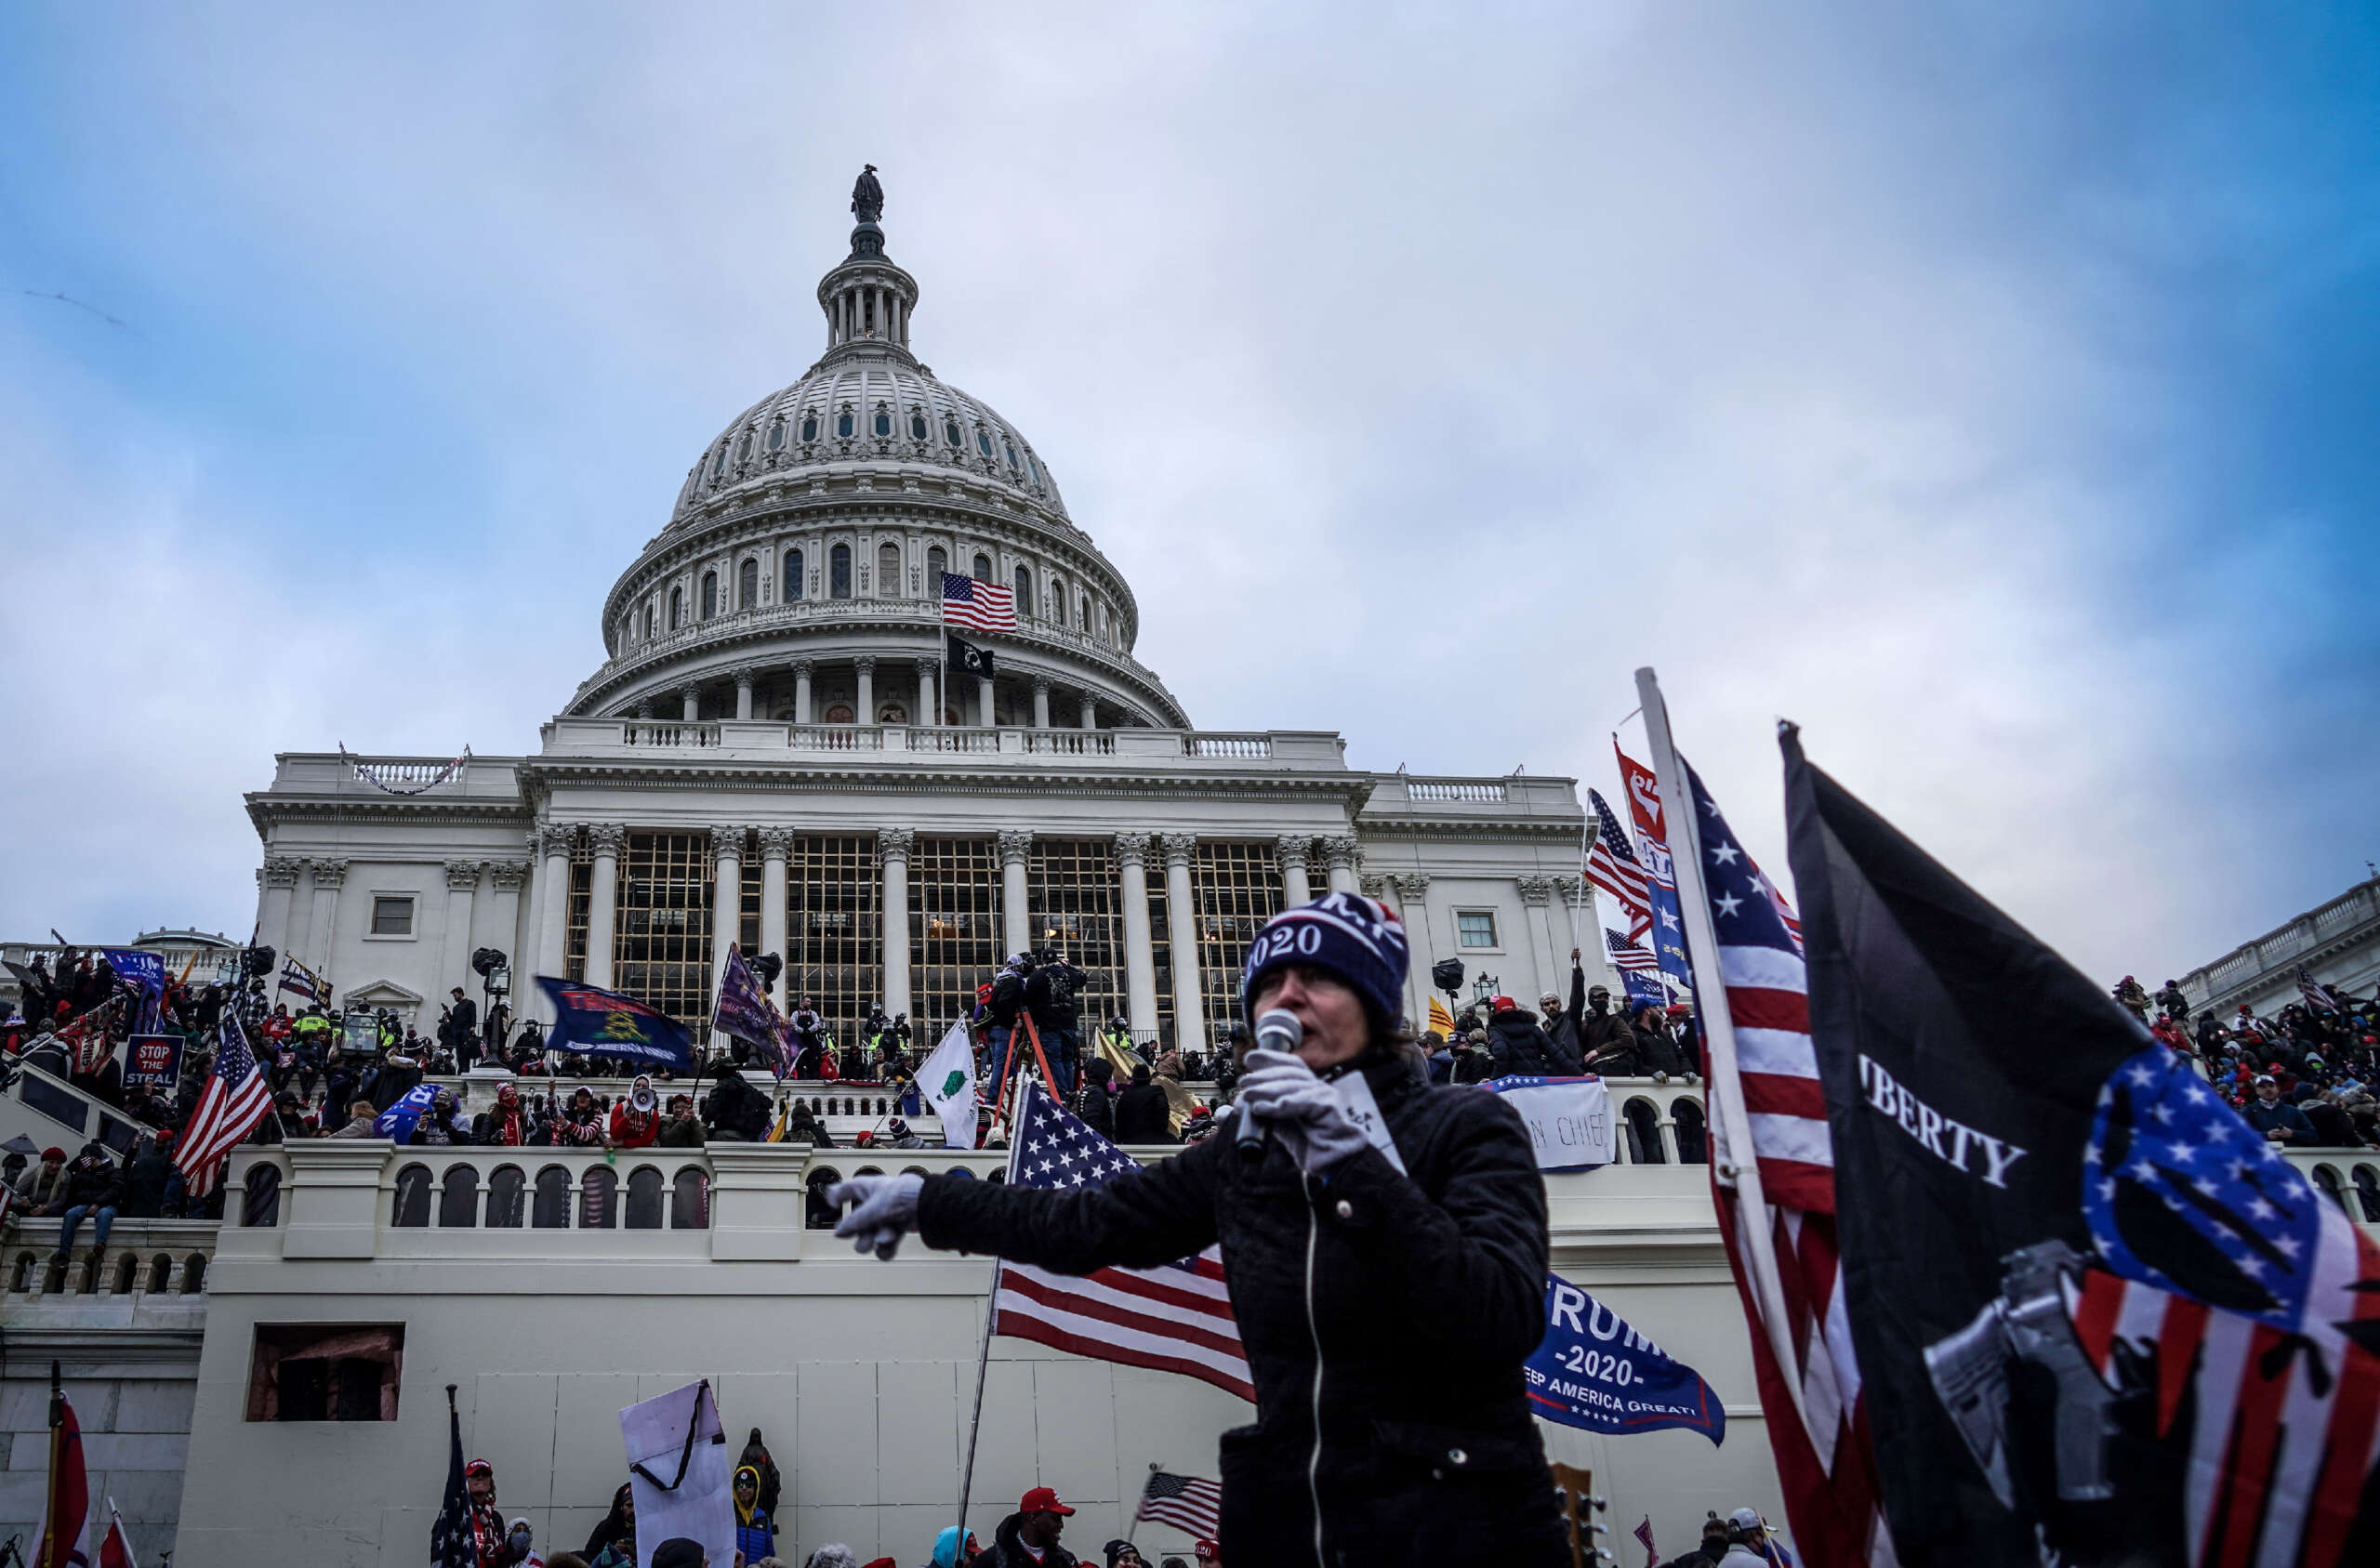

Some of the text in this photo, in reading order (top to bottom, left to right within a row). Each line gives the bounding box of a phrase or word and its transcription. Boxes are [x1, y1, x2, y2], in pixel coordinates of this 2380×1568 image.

[1246, 924, 1322, 981] 020
[139, 1046, 170, 1059] STOP
[142, 1061, 164, 1070] THE
[126, 1073, 173, 1085] STEAL
[1524, 1365, 1697, 1416] EEP AMERICA GREAT!
